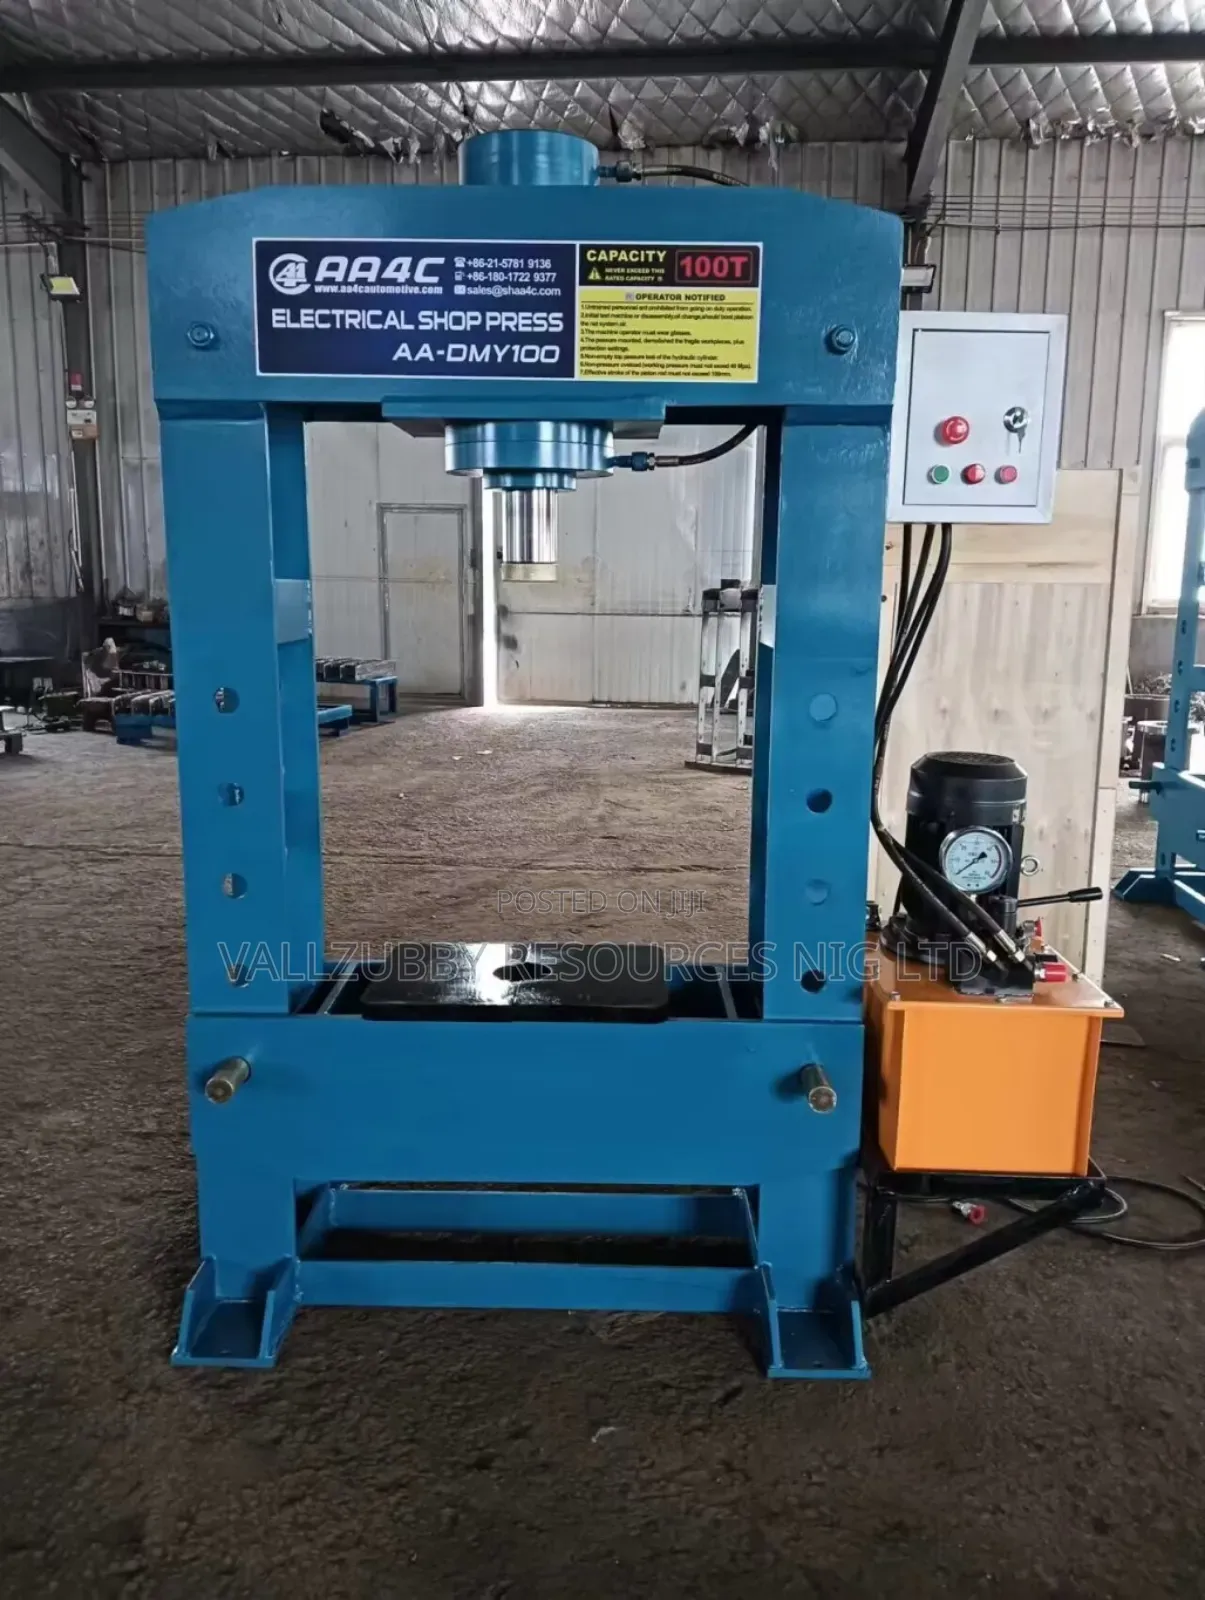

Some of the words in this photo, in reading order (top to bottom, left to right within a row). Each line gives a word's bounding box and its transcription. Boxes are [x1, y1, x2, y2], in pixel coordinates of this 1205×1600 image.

[586, 249, 667, 262] CAPACITY
[314, 255, 446, 283] AA4C
[466, 257, 525, 268] +86-21-5781
[528, 258, 552, 269] 9136
[680, 255, 749, 278] 100T
[466, 271, 531, 282] +86-180-1722
[533, 272, 557, 282] 9377
[314, 284, 443, 294] www.aa4cautomotive.com
[466, 285, 562, 298] sales@shaa4c.com
[635, 292, 682, 301] OPERATOR
[684, 294, 726, 302] NOTIFIED
[271, 308, 415, 330] ELECTRICAL
[418, 310, 482, 331] SHOP
[485, 311, 564, 332] PRESS
[392, 342, 560, 364] AA-DMY100
